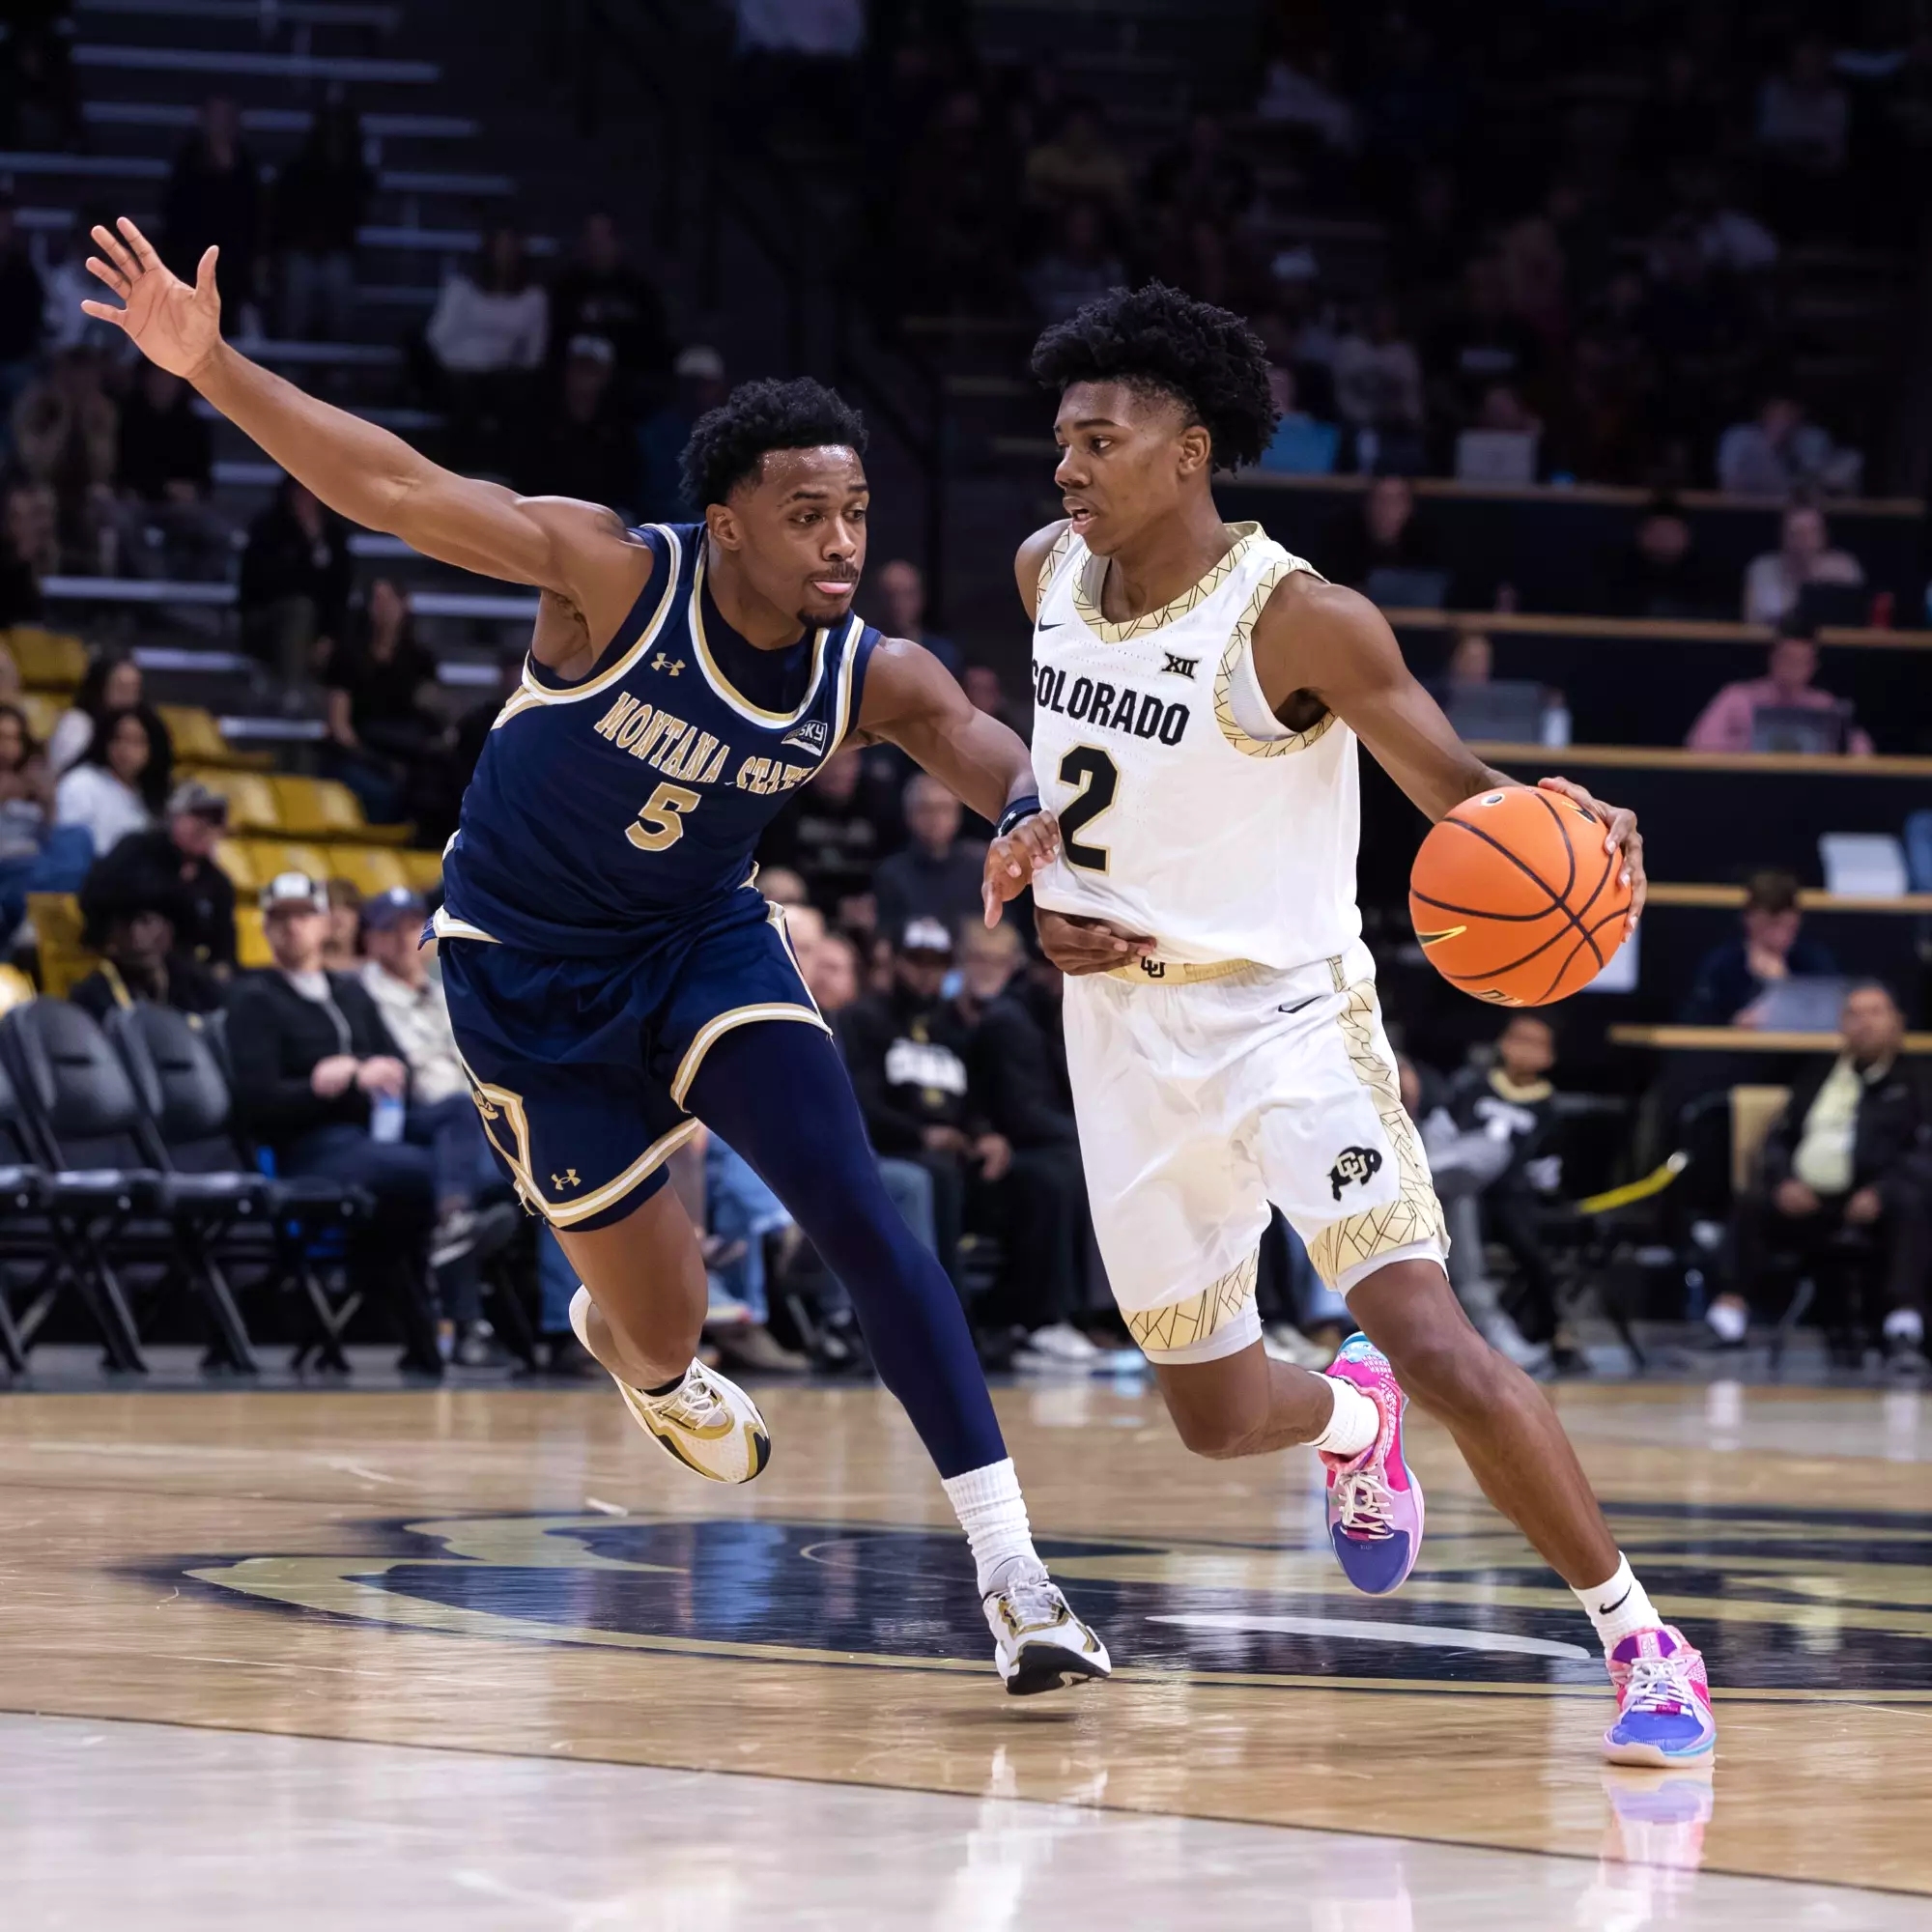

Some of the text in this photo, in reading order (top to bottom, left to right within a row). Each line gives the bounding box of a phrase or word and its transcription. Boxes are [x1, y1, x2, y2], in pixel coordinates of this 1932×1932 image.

[1161, 651, 1200, 680] XII
[593, 691, 730, 783] MONTANA
[624, 781, 702, 851] 5
[1056, 741, 1121, 877] 2
